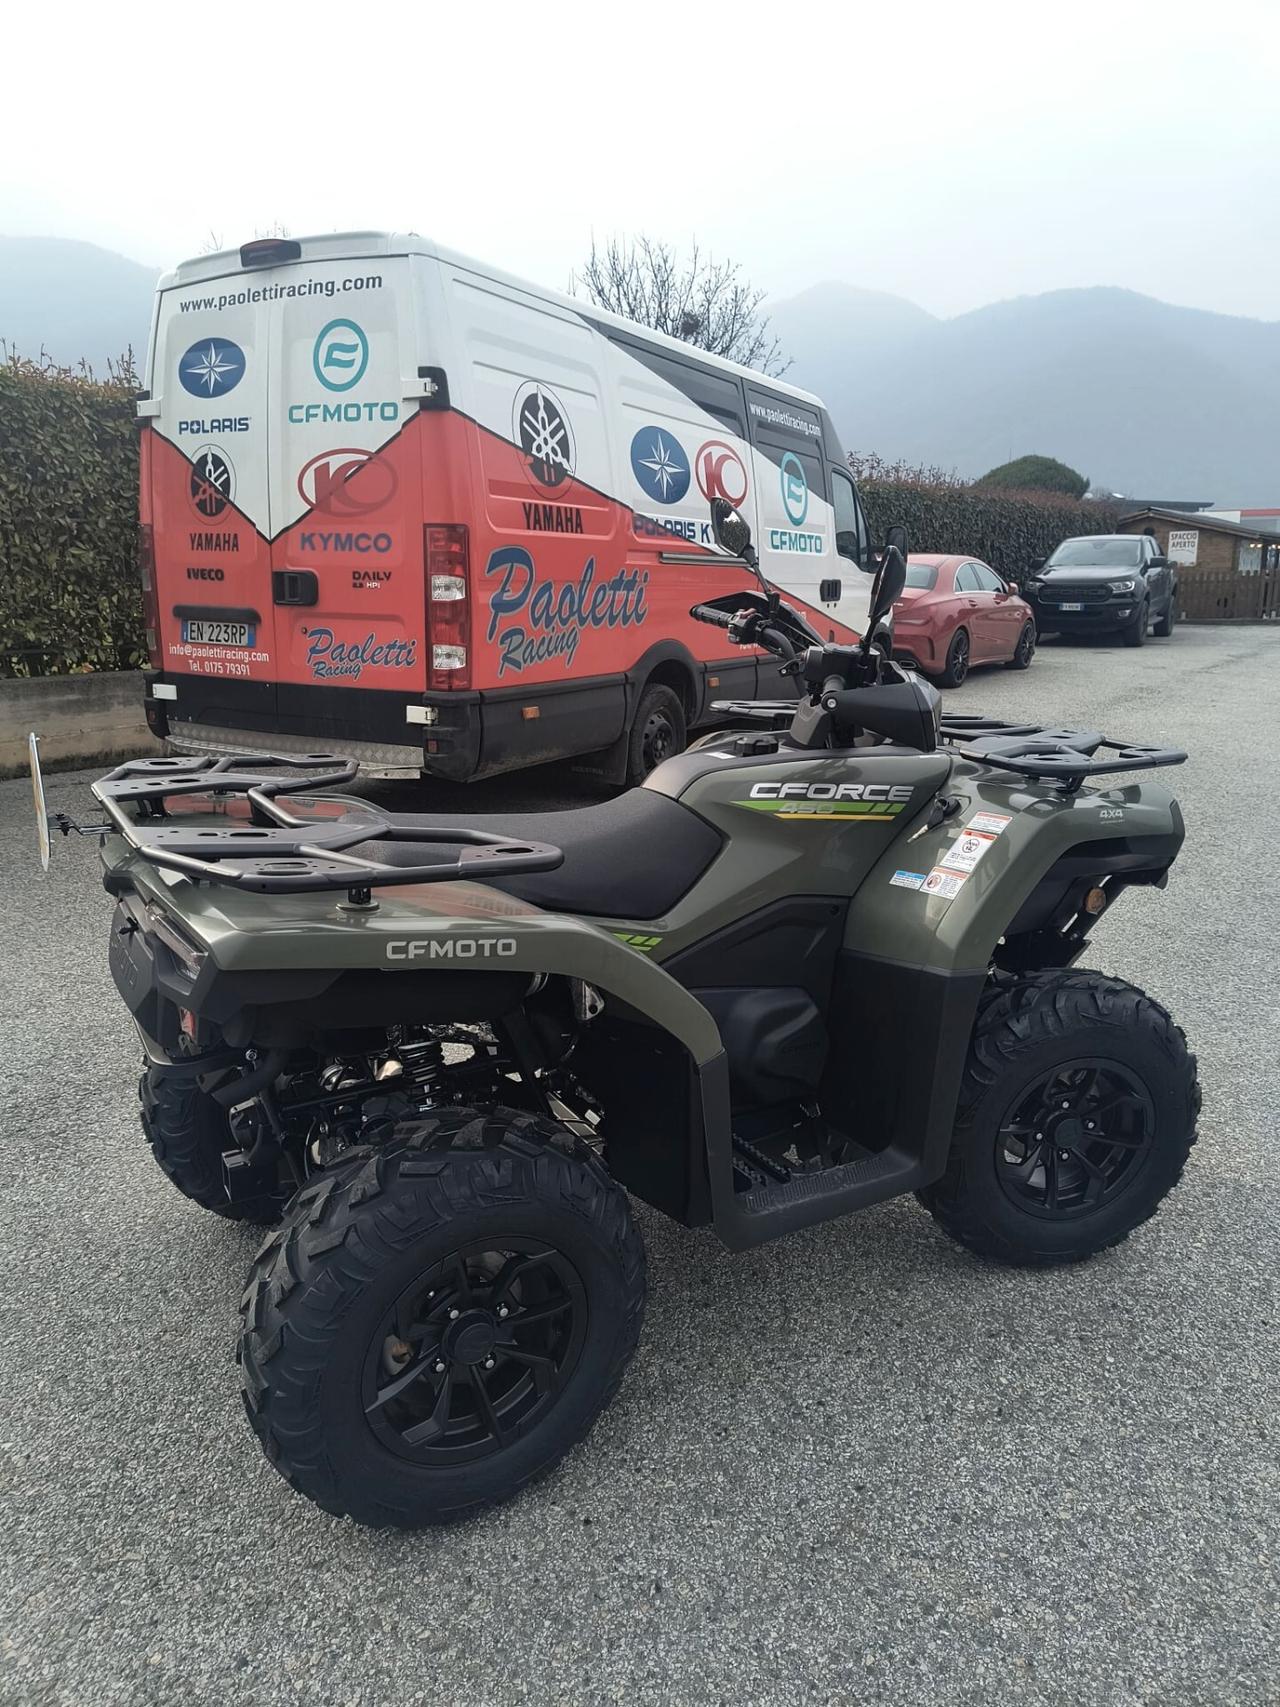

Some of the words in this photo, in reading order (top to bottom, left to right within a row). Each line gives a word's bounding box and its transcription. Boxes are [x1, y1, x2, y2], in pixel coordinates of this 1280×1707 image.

[180, 275, 382, 311] www.paolettiracing.com
[288, 402, 398, 424] CFMOTO
[749, 402, 822, 436] www.paolettiracing.com
[179, 417, 249, 434] POLARIS
[522, 502, 583, 534] YAMAHA
[634, 515, 696, 539] POLARIS
[190, 533, 239, 552] YAMAHA
[300, 532, 393, 553] KYMCO
[770, 530, 822, 553] CFMOTO
[1171, 532, 1197, 541] SPACCIO
[1171, 541, 1195, 549] APERTO
[187, 567, 224, 581] IVECO
[352, 571, 391, 581] DAILY
[486, 545, 649, 643] Paoletti
[169, 643, 270, 662] info@paolettiracing.com
[307, 627, 417, 667] Paoletti
[499, 626, 579, 677] Racing
[188, 660, 203, 672] Tel.
[204, 661, 224, 674] 0175
[225, 663, 250, 675] 79391
[313, 660, 362, 681] Racing
[750, 782, 915, 801] CFORCE
[386, 938, 517, 960] CFMOTO
